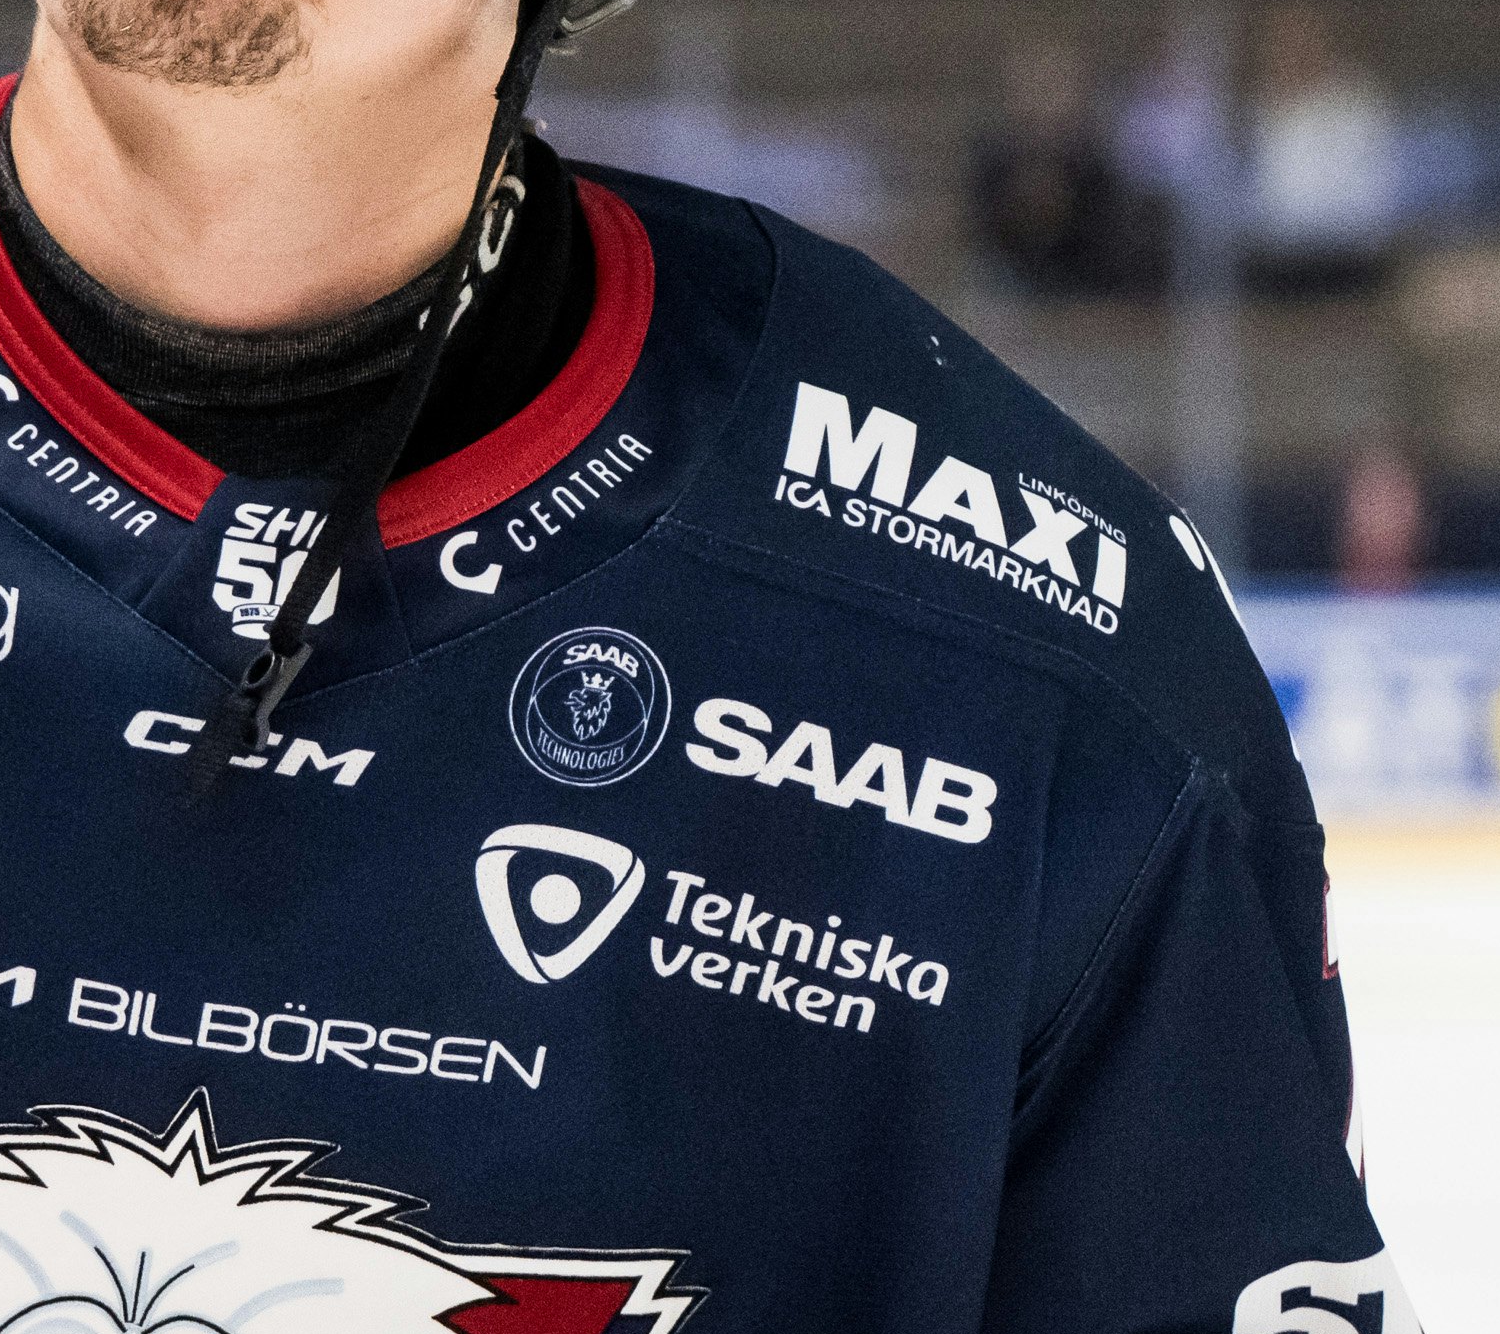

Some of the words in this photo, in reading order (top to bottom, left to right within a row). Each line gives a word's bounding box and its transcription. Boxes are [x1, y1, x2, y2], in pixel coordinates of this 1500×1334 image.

[7, 424, 158, 537] CENTRIA
[506, 433, 653, 552] CENTRIA
[783, 381, 1127, 609] MAXI
[1018, 472, 1127, 545] LINKÖPING
[775, 475, 832, 518] ICA
[842, 498, 1119, 635] STORMARKNAD
[563, 643, 640, 678] SAAB
[537, 727, 627, 770] TECHNOLOGIES
[685, 698, 998, 844] SAAB
[650, 936, 876, 1033] verken
[662, 870, 950, 1008] Tekniska
[67, 976, 547, 1090] BILBÖRSEN
